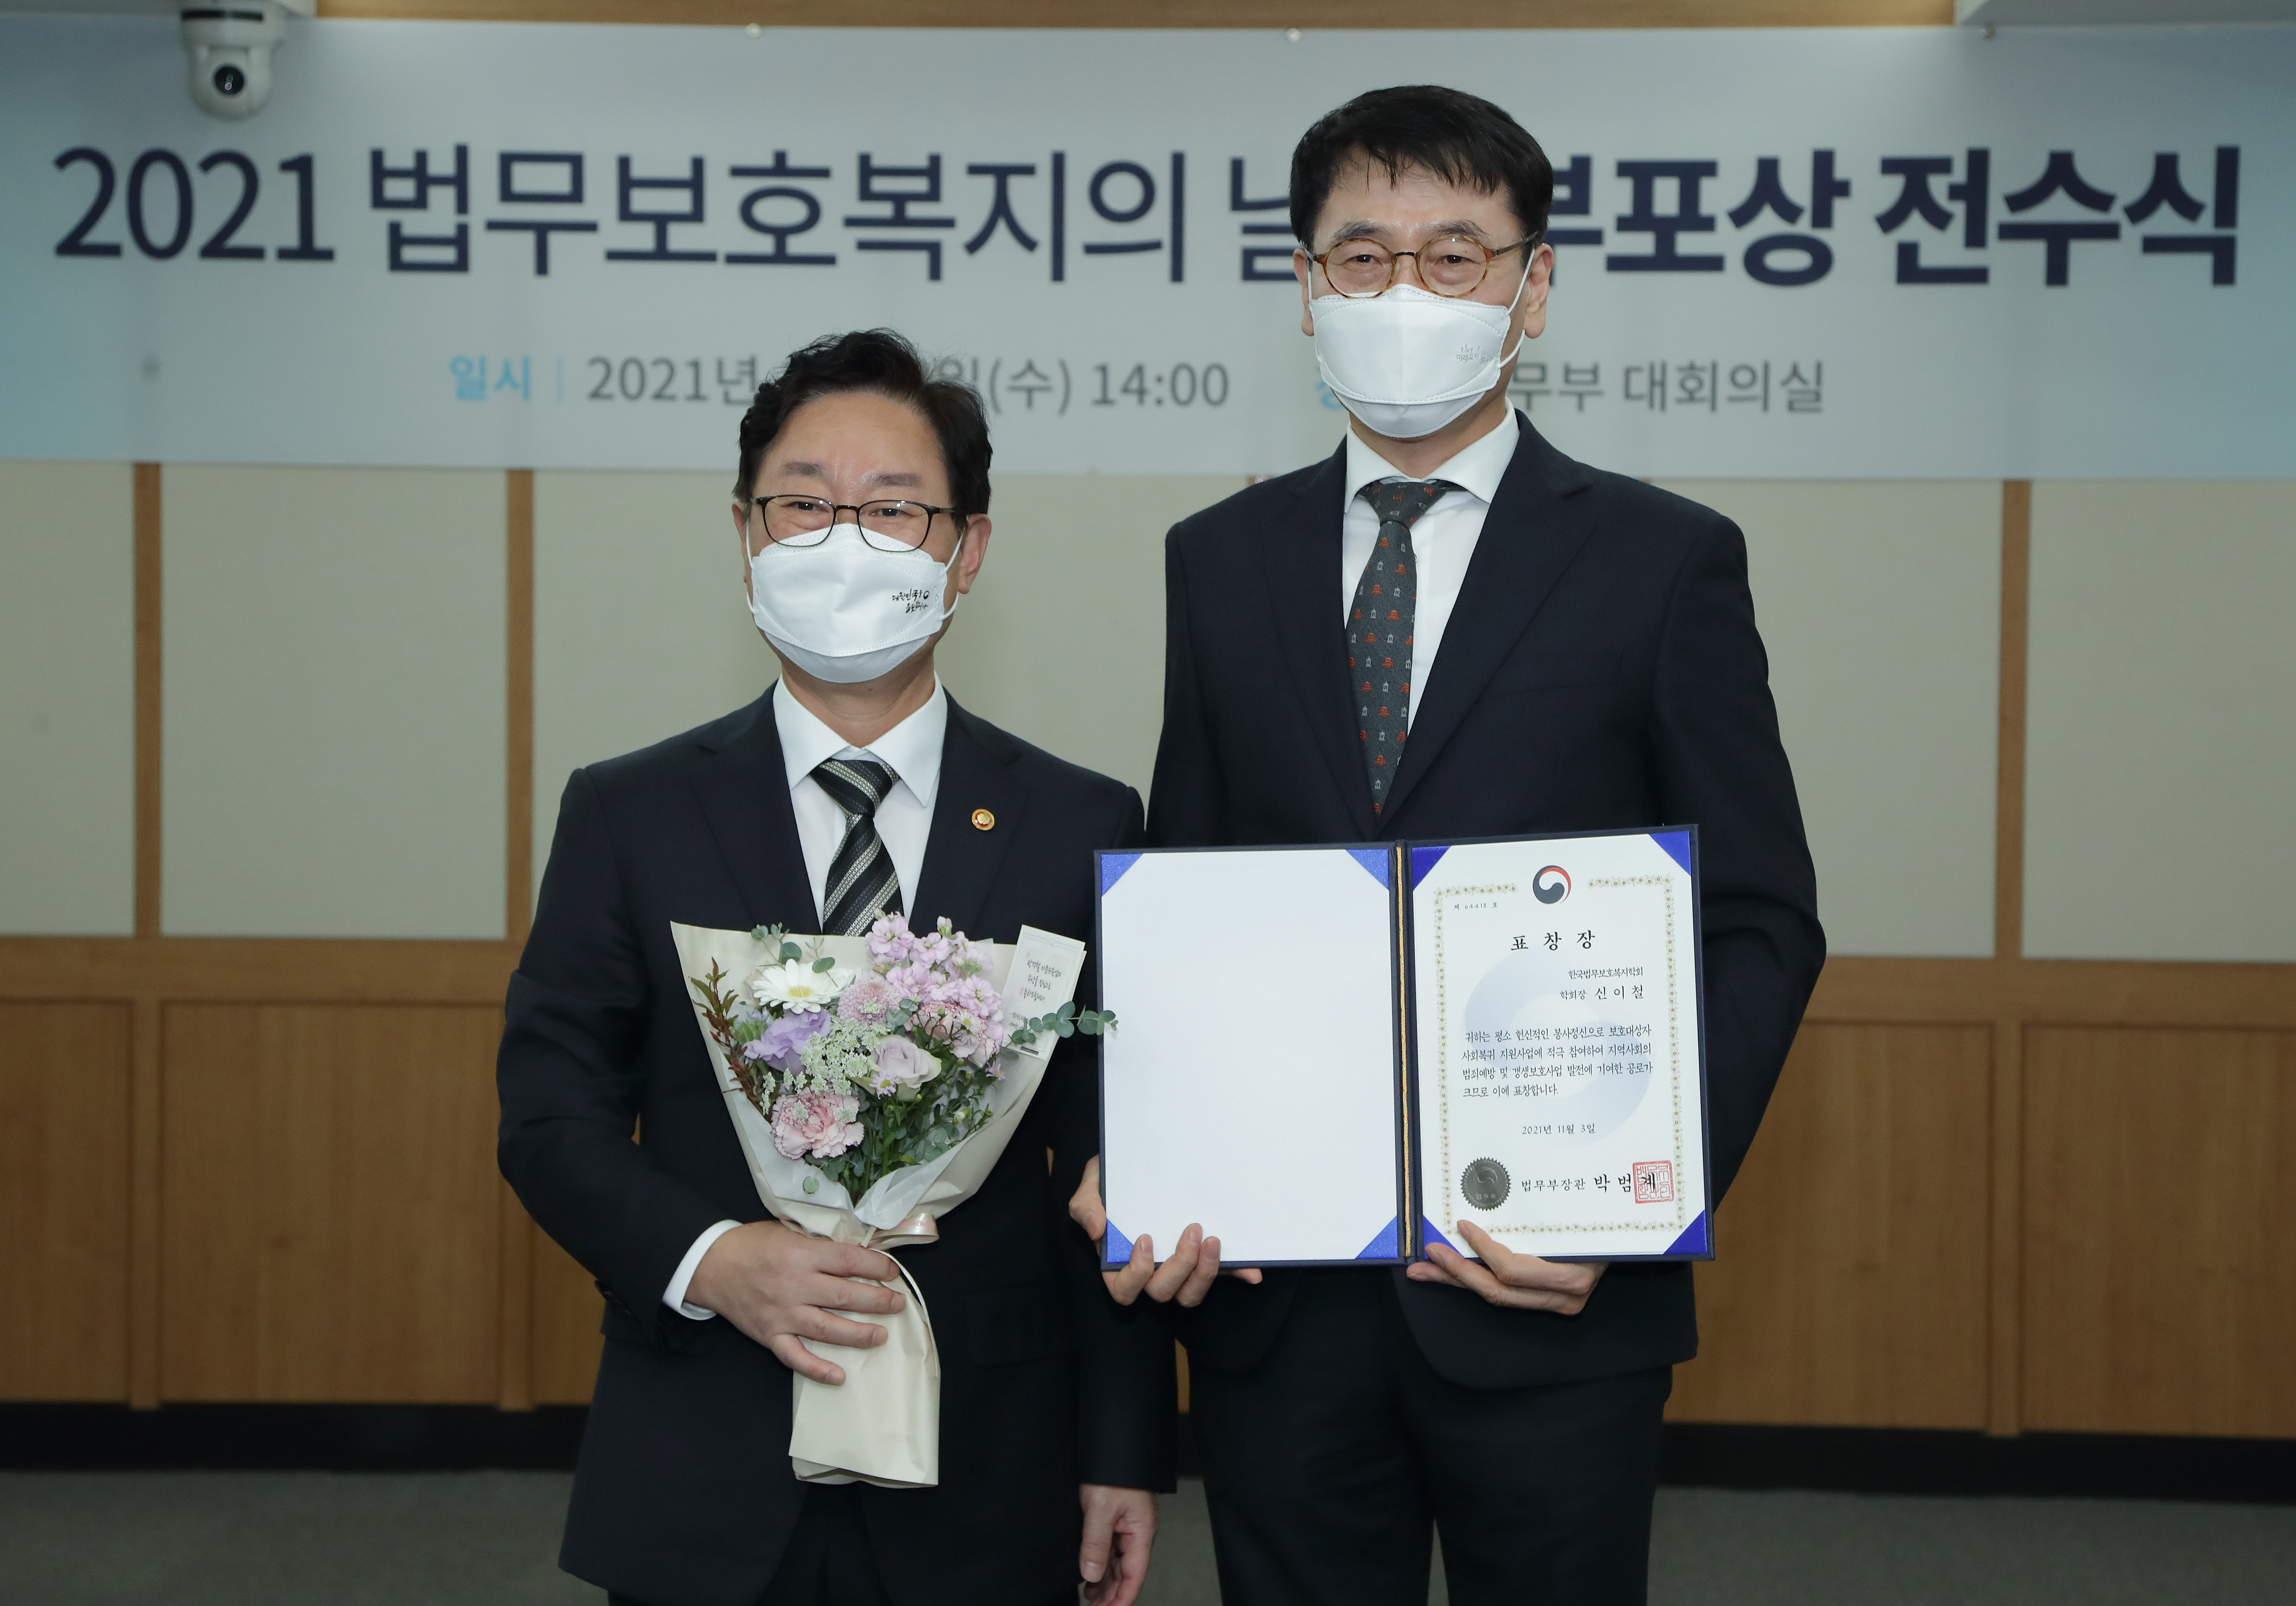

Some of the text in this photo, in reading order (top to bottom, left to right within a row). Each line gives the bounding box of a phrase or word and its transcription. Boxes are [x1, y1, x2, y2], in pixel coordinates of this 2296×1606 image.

[52, 145, 335, 262] 2021
[368, 143, 1186, 284] 법무보호복지의
[1875, 144, 2242, 288] 전수식
[445, 351, 536, 404] 일시
[584, 351, 761, 407] 2021년
[1089, 354, 1233, 412] 14:00
[1623, 356, 1826, 417] 대회의실
[1568, 966, 1643, 979] 한국법무보호복지학회
[1559, 989, 1587, 1001] 학회장
[1465, 1024, 1652, 1044] 귀하는 평소 헌신적인 봉사정신으로 보호대상자
[1461, 1043, 1651, 1062] 사회복귀 지원사업에 적극 참여하여 지역사회의
[1462, 1061, 1653, 1080] 범죄예방 및 갱생보호사업 발전에 기여한 공로가
[1463, 1083, 1557, 1098] 크므로 이에 표창합니다.
[1522, 1123, 1595, 1135] 2021년 11월 3일
[1521, 1178, 1586, 1193] 법무부장관
